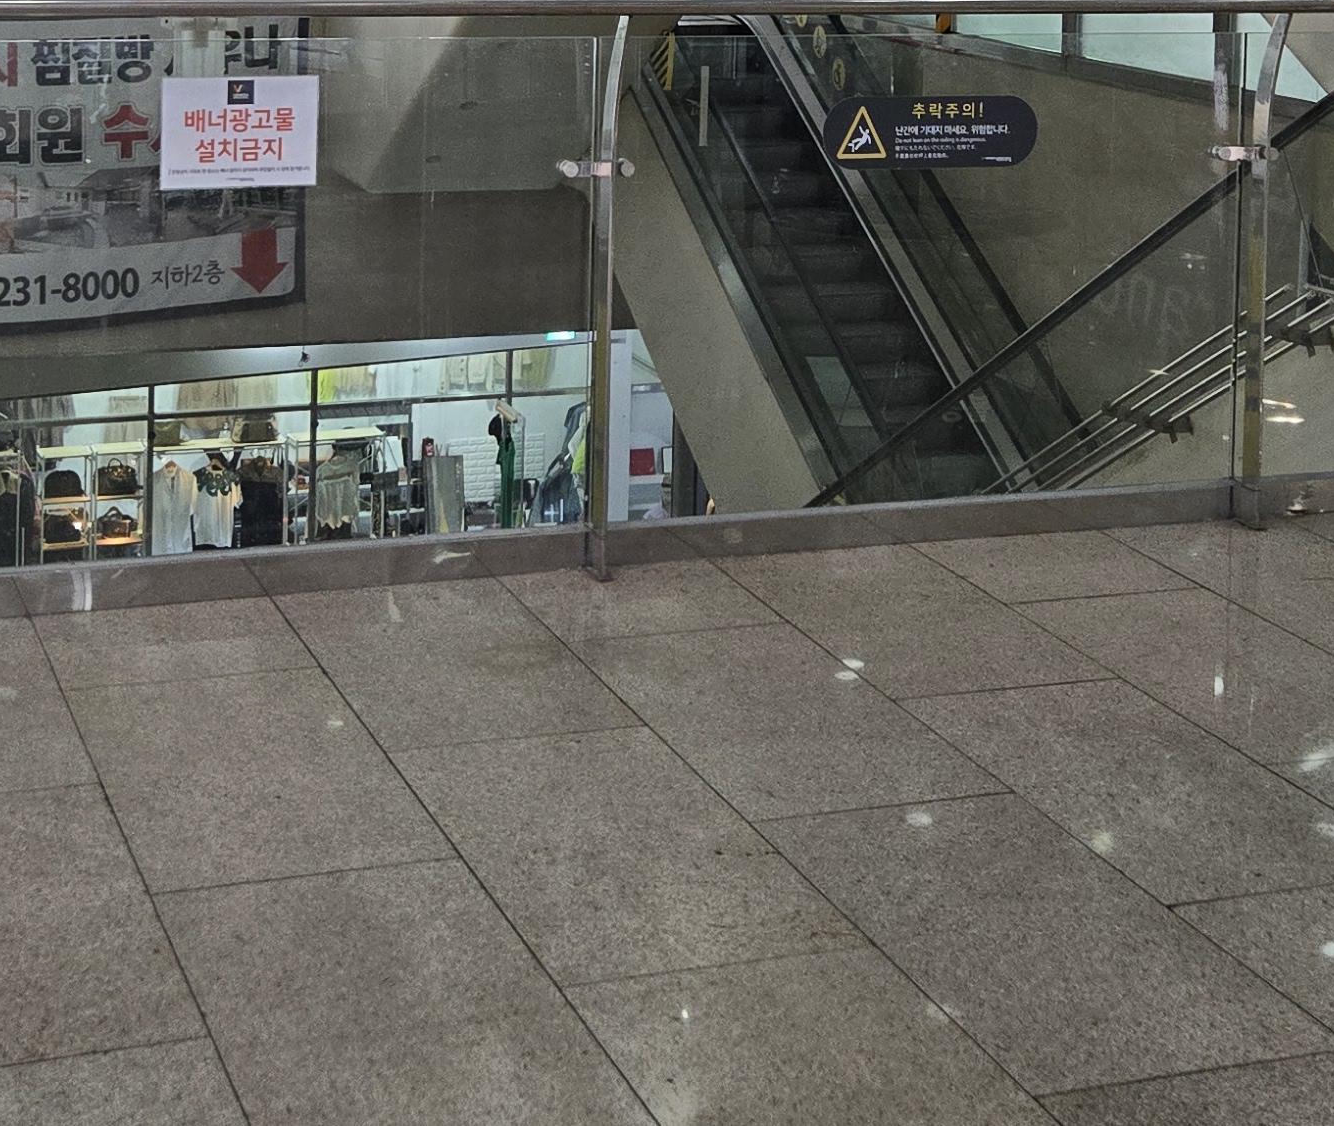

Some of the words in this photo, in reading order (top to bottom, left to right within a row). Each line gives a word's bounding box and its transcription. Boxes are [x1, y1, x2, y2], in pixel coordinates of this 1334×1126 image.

[30, 34, 153, 86] 찜질방
[184, 107, 295, 134] 배너광고물
[911, 102, 984, 119] 추락주의!
[103, 103, 161, 162] 수
[895, 125, 919, 136] 난간에
[920, 125, 943, 136] 기대지
[195, 137, 283, 163] 설치금지
[150, 264, 225, 289] 지하2층
